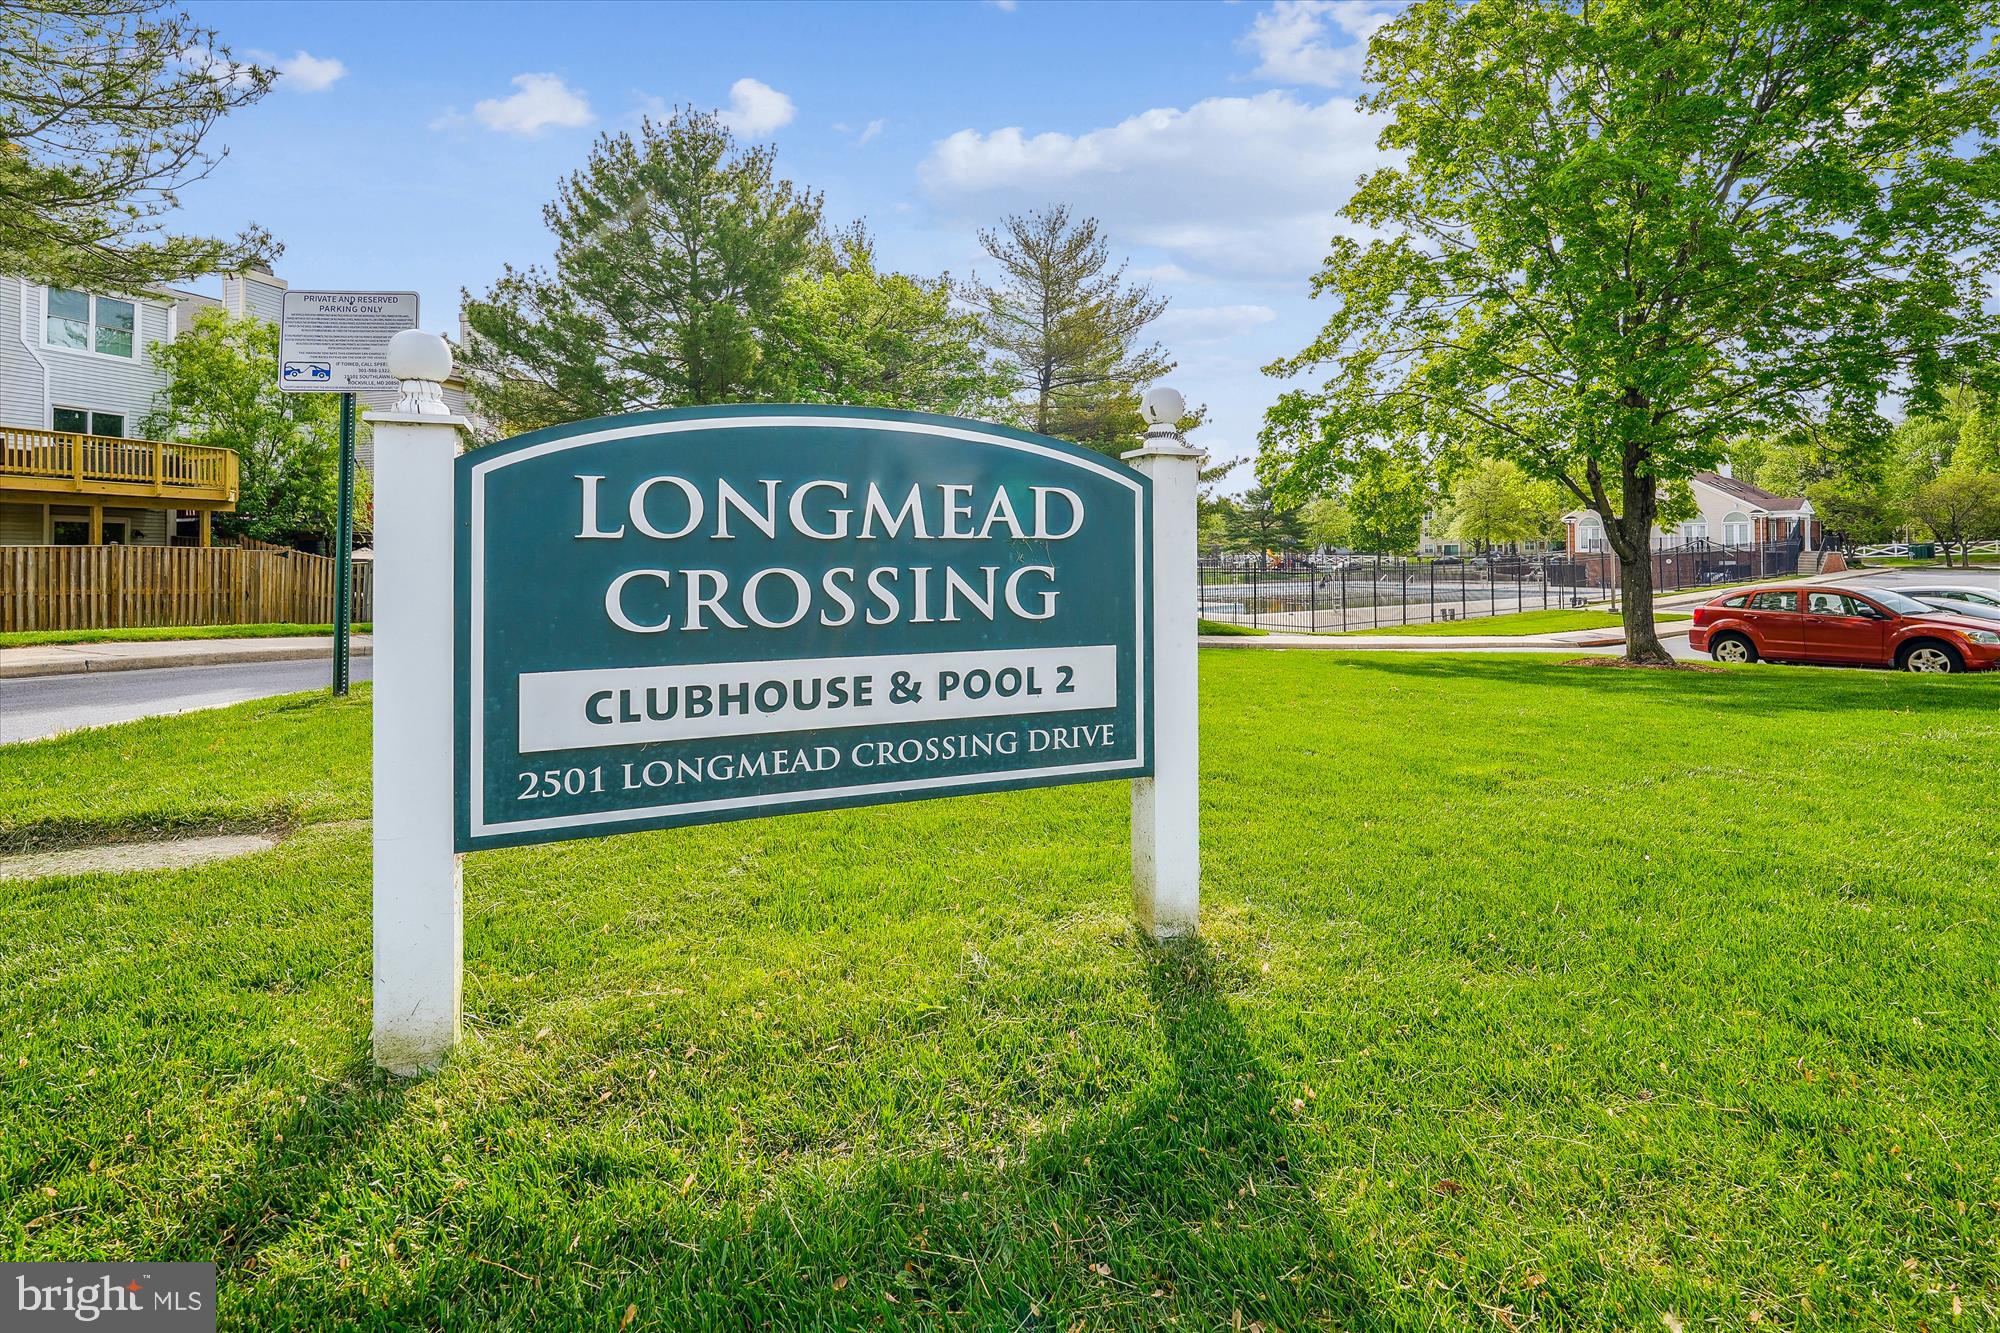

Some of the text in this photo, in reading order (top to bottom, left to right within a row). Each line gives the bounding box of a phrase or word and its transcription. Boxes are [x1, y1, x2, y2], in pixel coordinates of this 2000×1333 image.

[303, 295, 399, 304] PRIVATE AND RESERVED
[319, 305, 383, 313] PARKING ONLY
[573, 474, 1086, 541] LONGMEAD
[604, 564, 1061, 633] CROSSING
[585, 665, 1076, 725] CLUBHOUSE & POOL 2
[517, 723, 1115, 801] 2501 LONGMEAD CROSSING DRIVE
